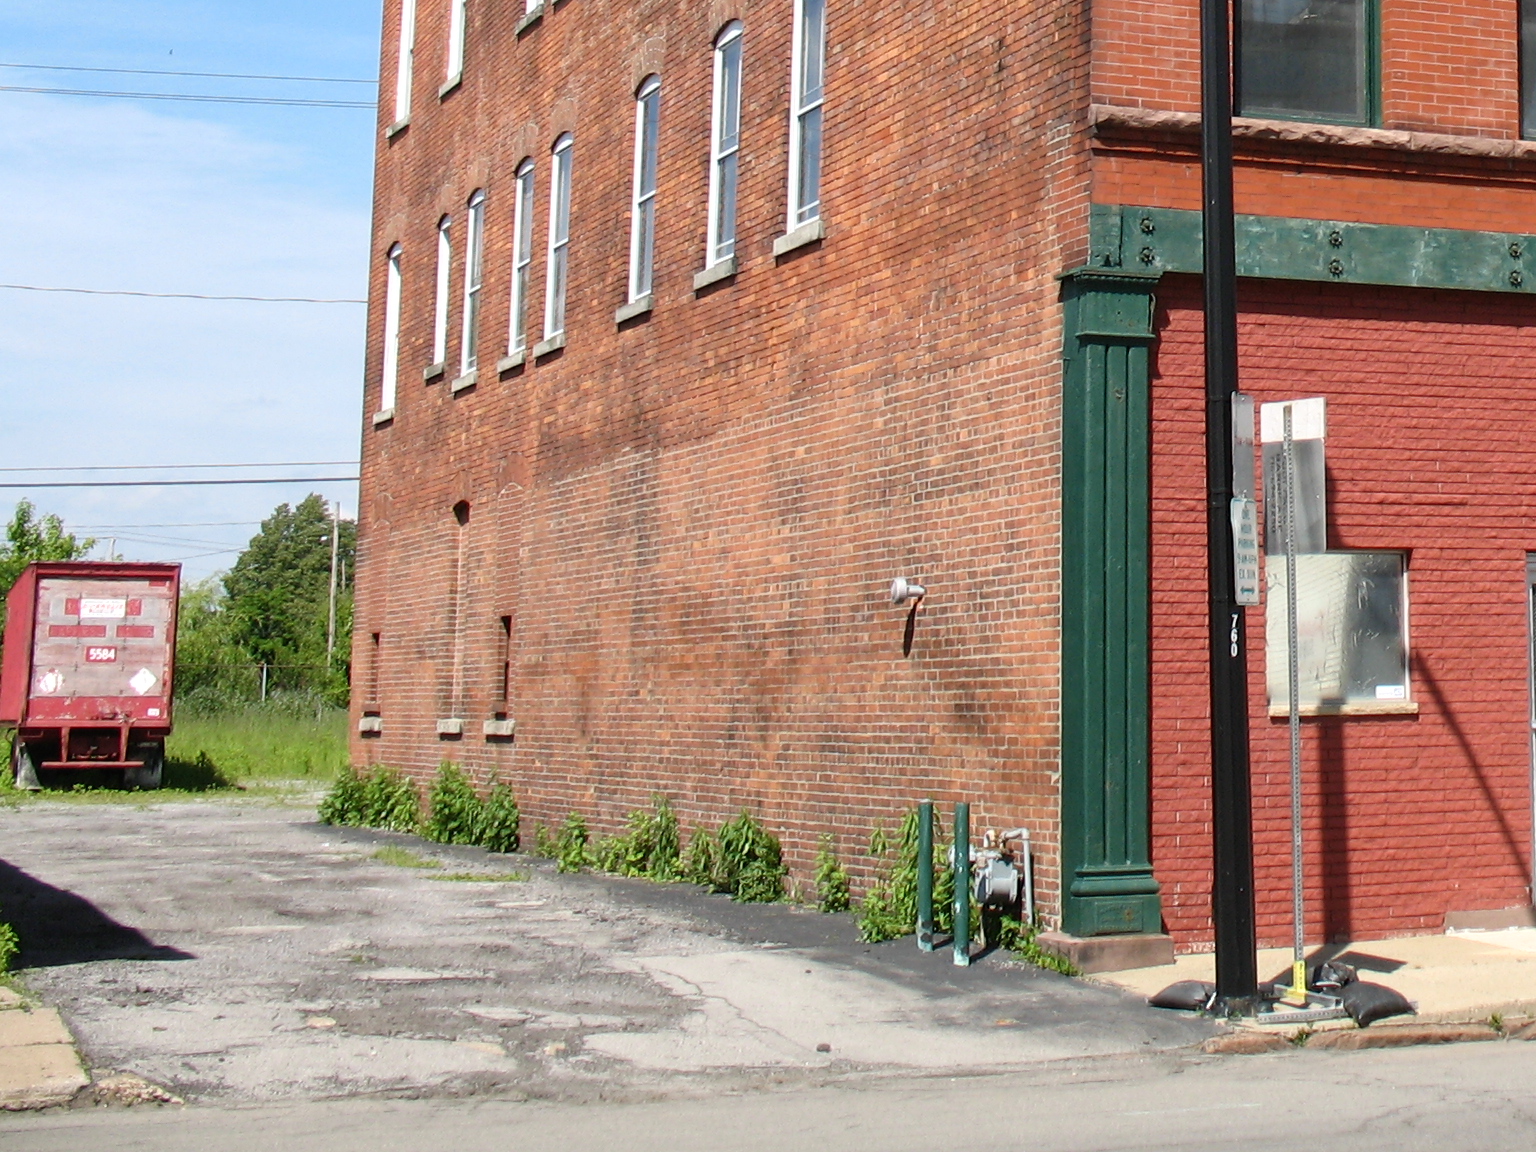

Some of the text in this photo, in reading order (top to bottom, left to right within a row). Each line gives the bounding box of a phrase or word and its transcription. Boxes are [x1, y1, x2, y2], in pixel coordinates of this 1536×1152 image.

[1238, 537, 1255, 549] PARKING
[1230, 613, 1238, 657] 760
[89, 648, 115, 660] 5584
